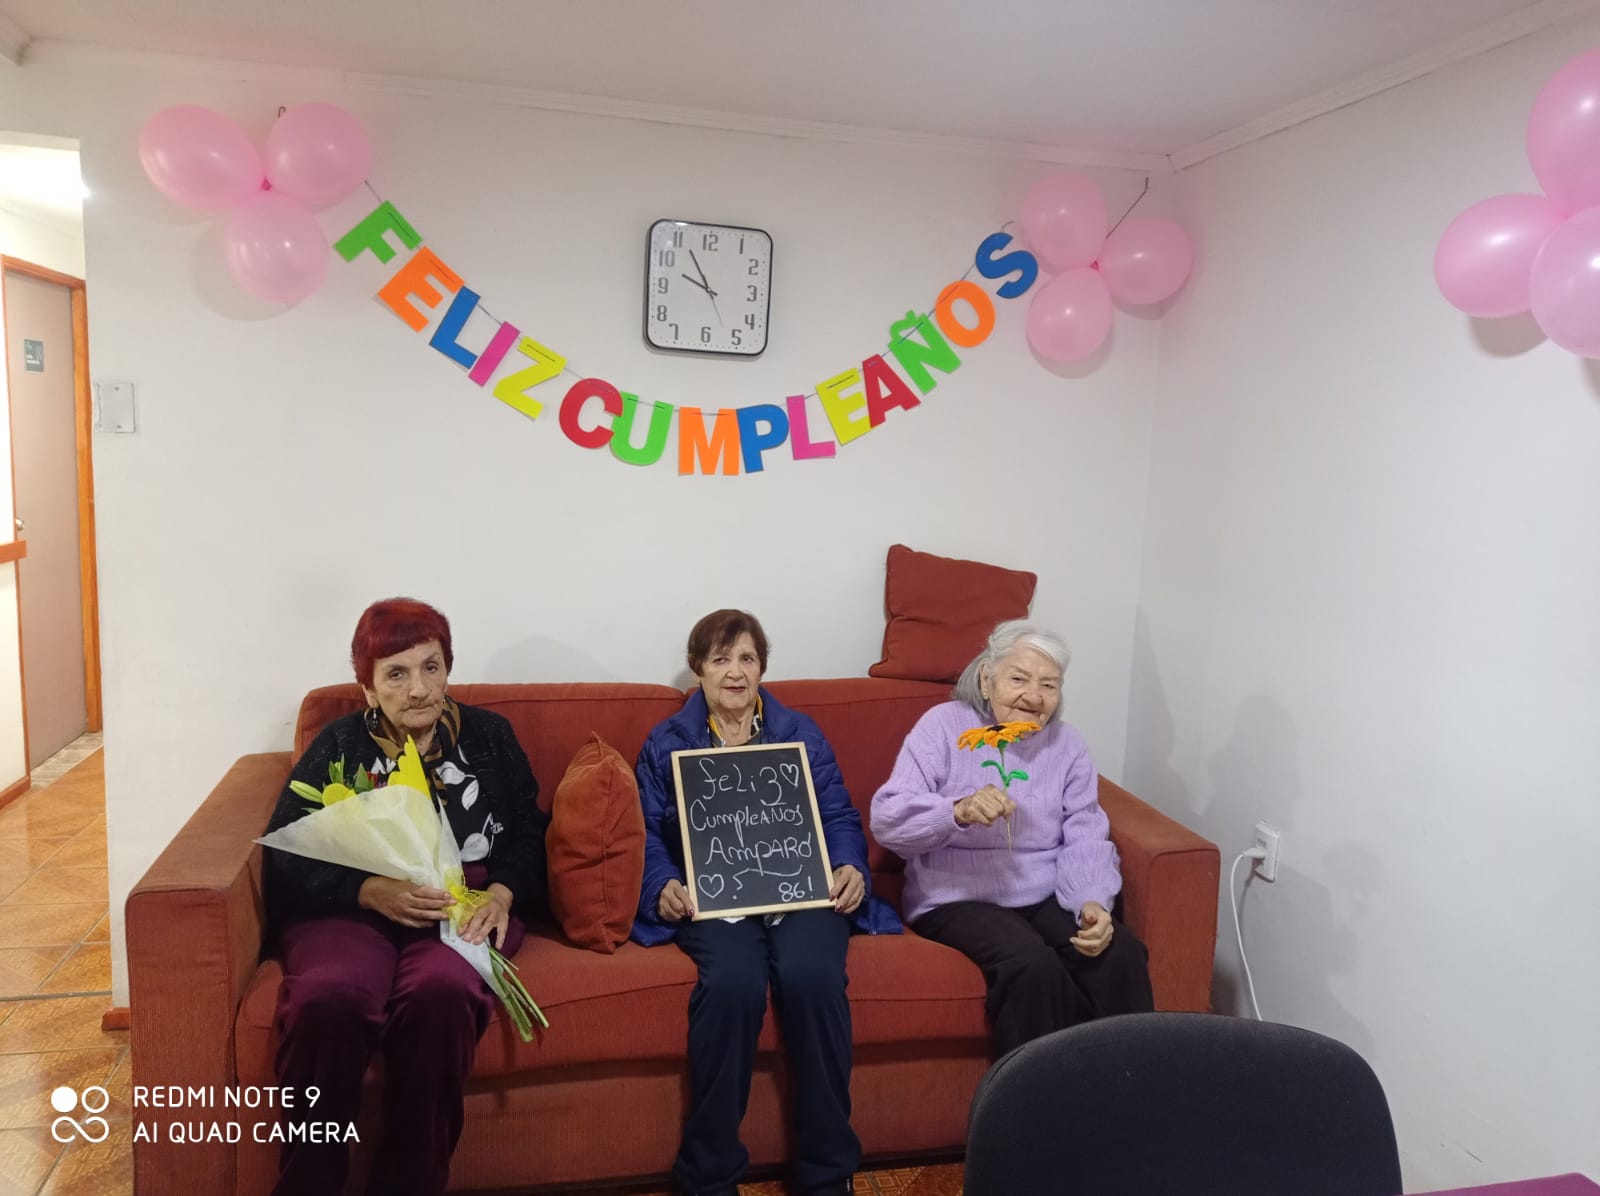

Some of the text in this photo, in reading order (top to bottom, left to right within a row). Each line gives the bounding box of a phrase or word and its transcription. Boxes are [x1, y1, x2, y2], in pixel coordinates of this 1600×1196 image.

[673, 231, 683, 248] 11
[702, 233, 719, 252] 12
[739, 237, 744, 255] 1
[659, 249, 675, 268] 10
[748, 258, 759, 276] 2
[658, 277, 668, 294] 9
[746, 285, 757, 302] 3
[657, 305, 667, 322] 8
[744, 313, 755, 330] 4
[332, 200, 1039, 475] FELIZ CUMPLEAÑOS
[669, 323, 679, 340] 7
[701, 326, 711, 343] 6
[731, 329, 742, 346] 5
